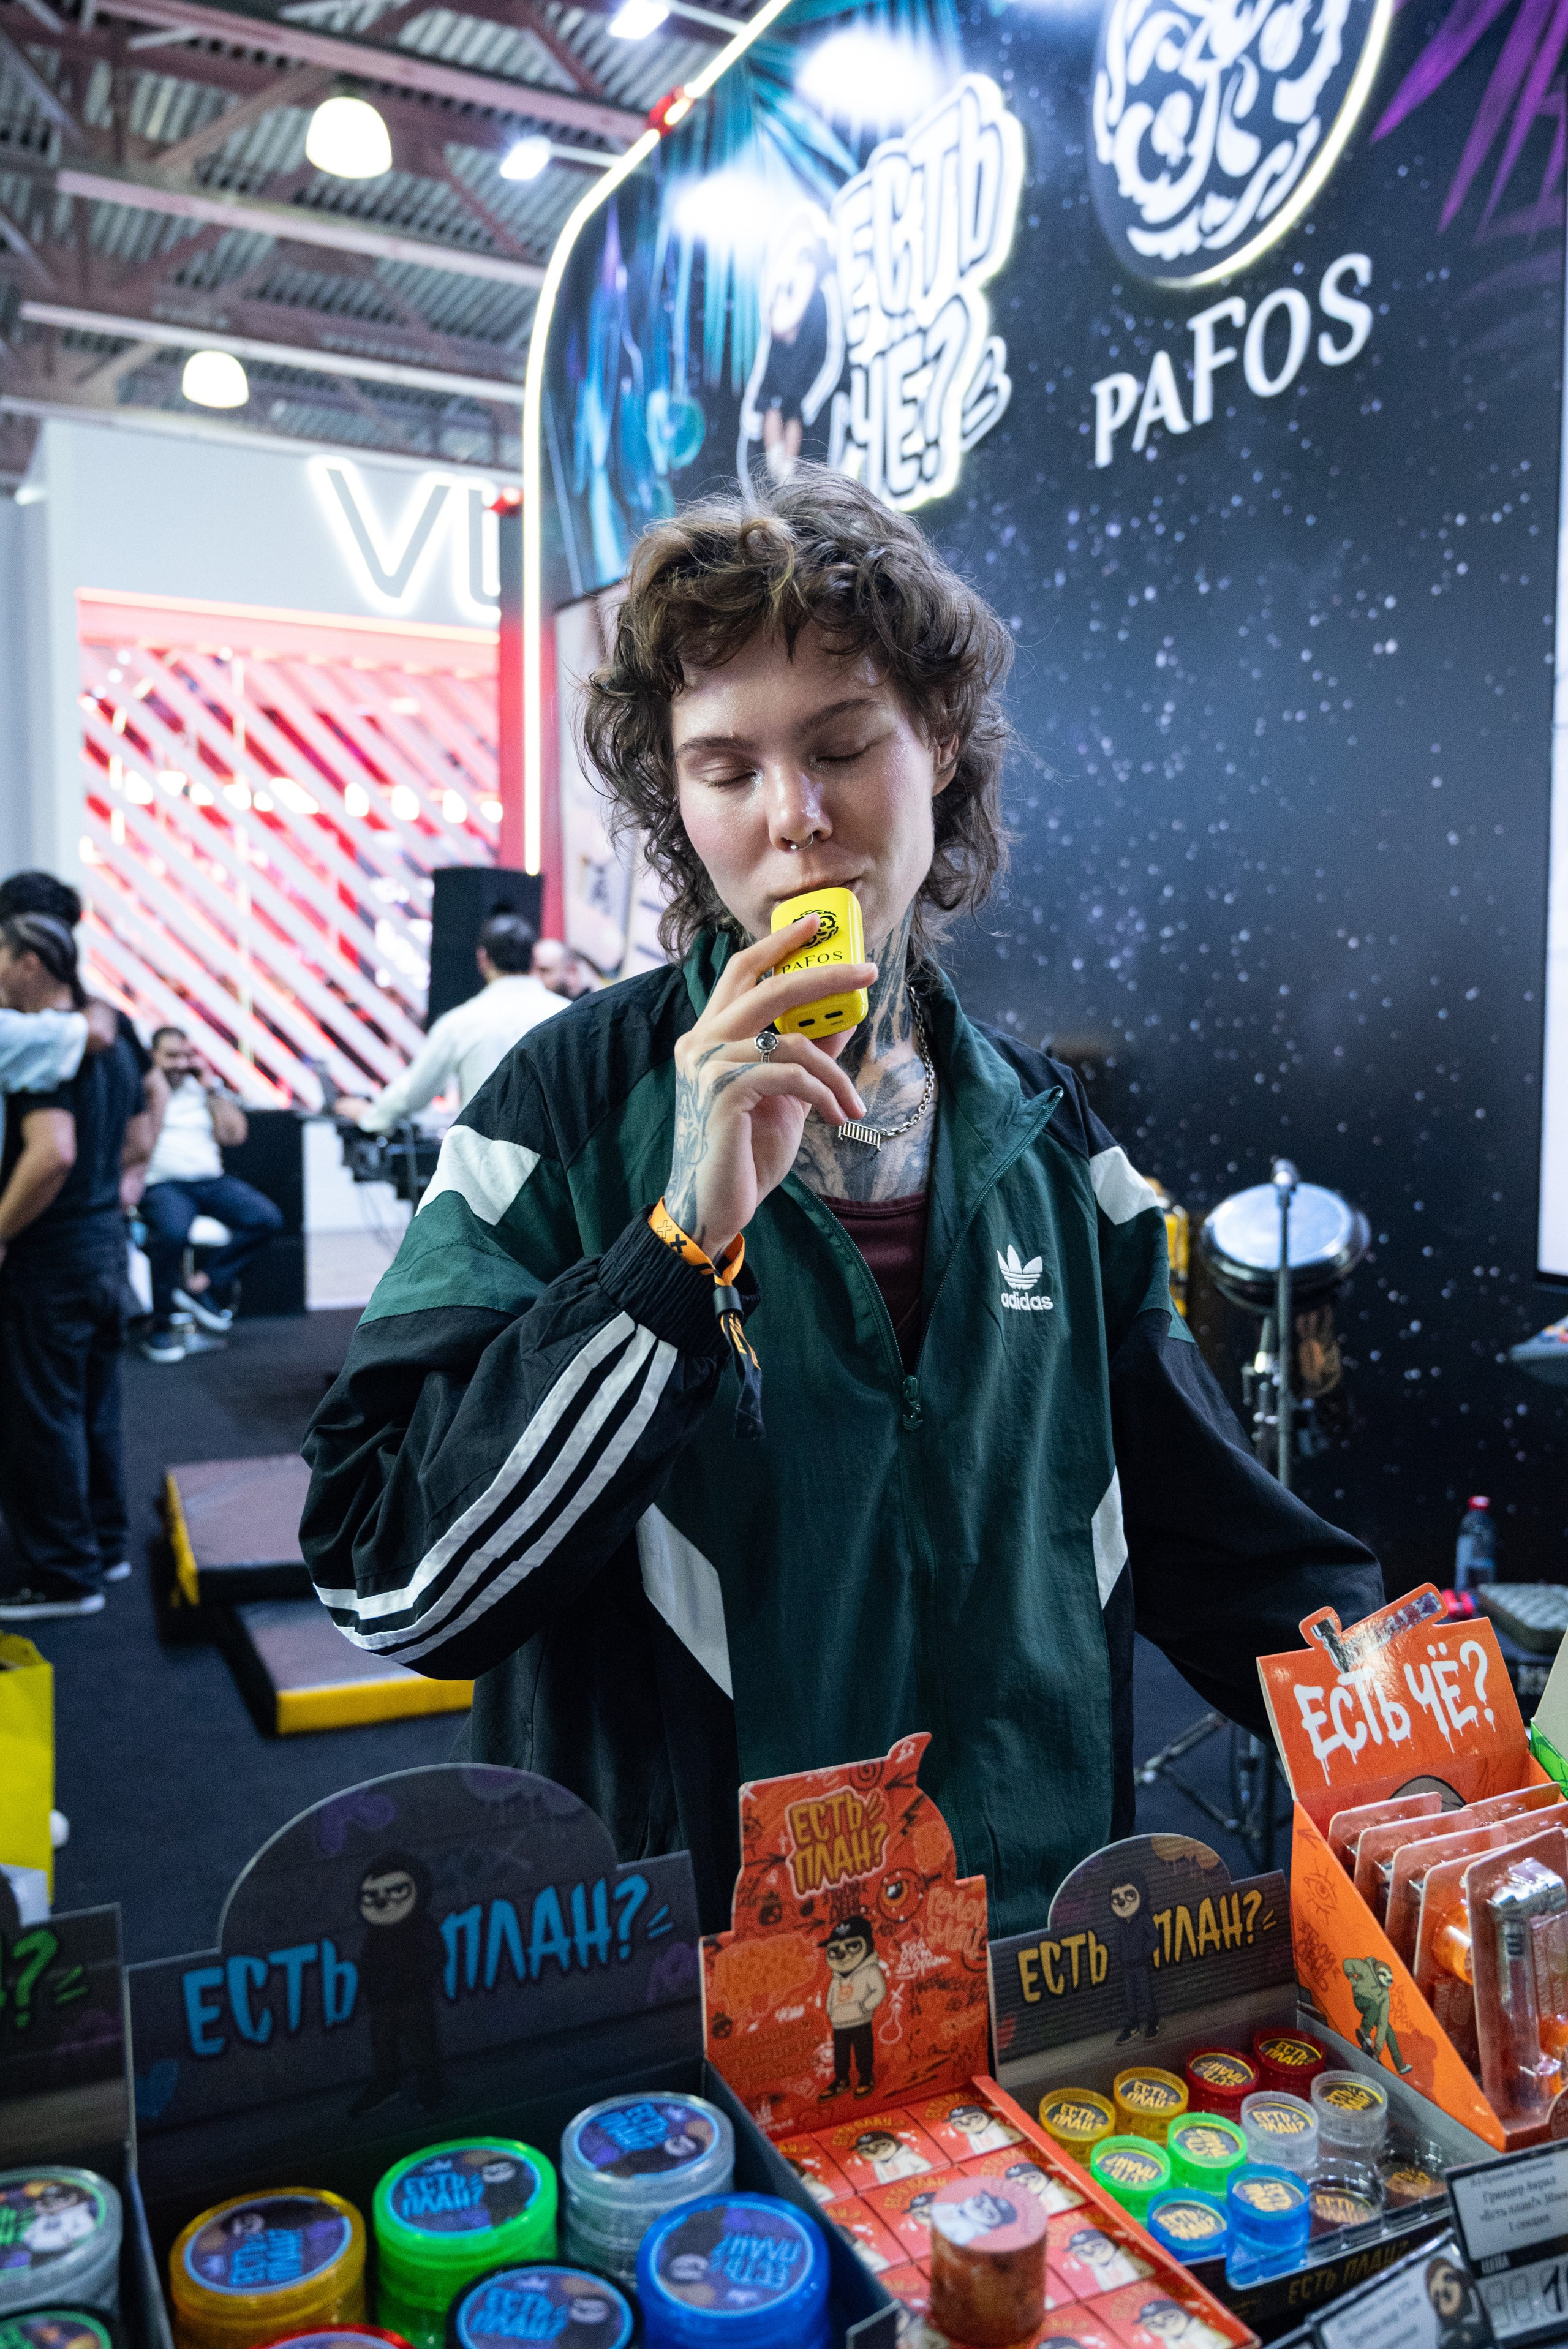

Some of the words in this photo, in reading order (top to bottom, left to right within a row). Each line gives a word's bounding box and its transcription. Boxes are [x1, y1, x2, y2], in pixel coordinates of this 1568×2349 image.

[1090, 252, 1373, 469] PAFOS
[782, 951, 843, 974] PAFOS
[1001, 1291, 1054, 1311] adidas
[1294, 1667, 1411, 1776] ЕСТЬ
[1403, 1640, 1496, 1753] ЧЁ?
[794, 1822, 889, 1892] ПЛАН?
[795, 1789, 865, 1845] ЕСТЬ
[183, 1938, 360, 2056] ЕСТЬ
[439, 1873, 649, 1999] ПЛАН?
[1017, 1929, 1109, 2003] ЕСТЬ
[1152, 1888, 1264, 1969] ПЛАН?
